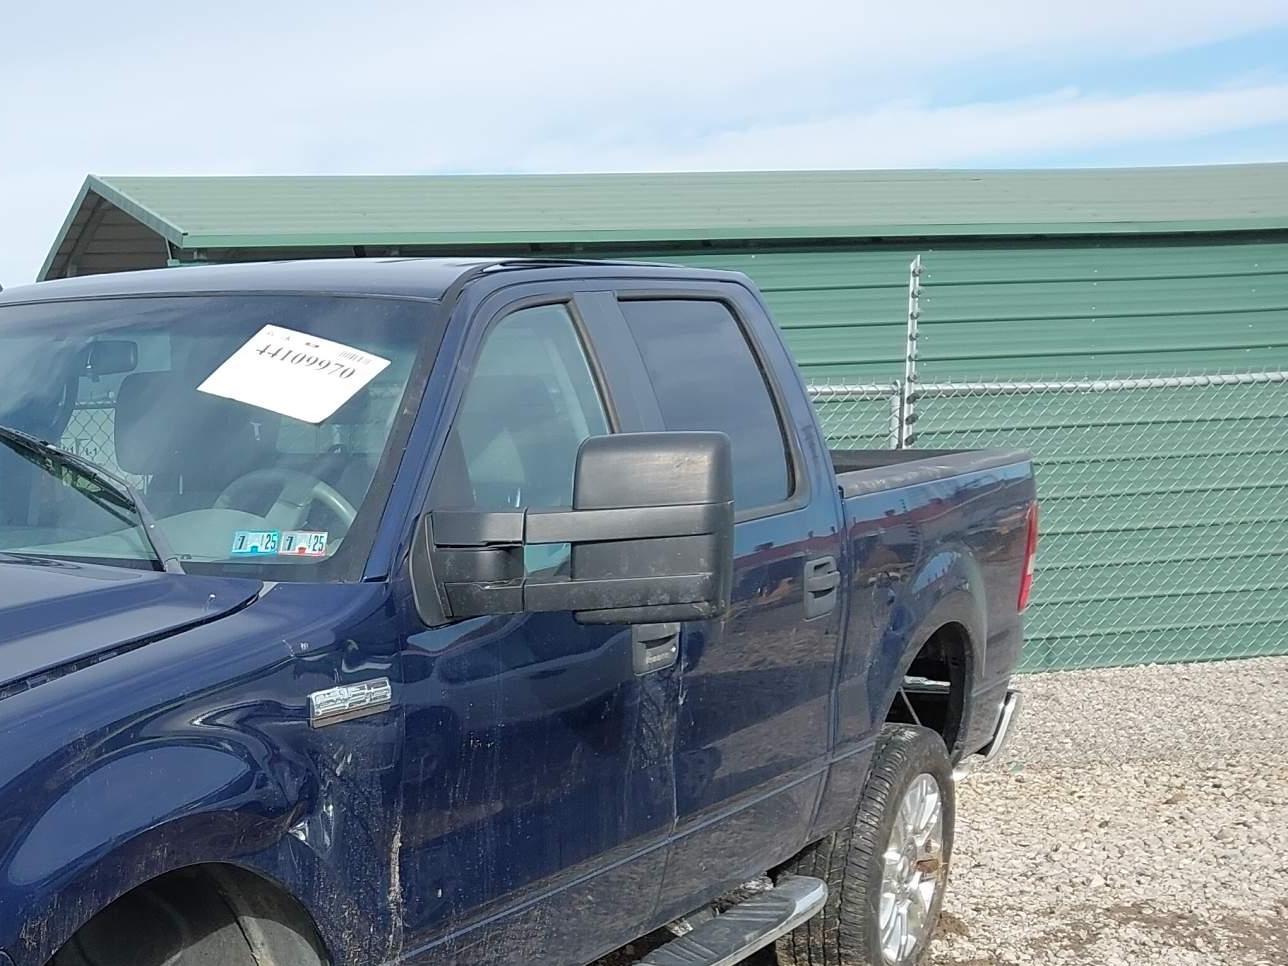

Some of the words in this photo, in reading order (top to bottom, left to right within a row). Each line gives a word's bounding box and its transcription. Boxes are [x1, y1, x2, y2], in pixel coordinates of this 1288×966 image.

[255, 343, 357, 380] 44109970
[264, 534, 277, 550] 25
[312, 535, 325, 552] 25
